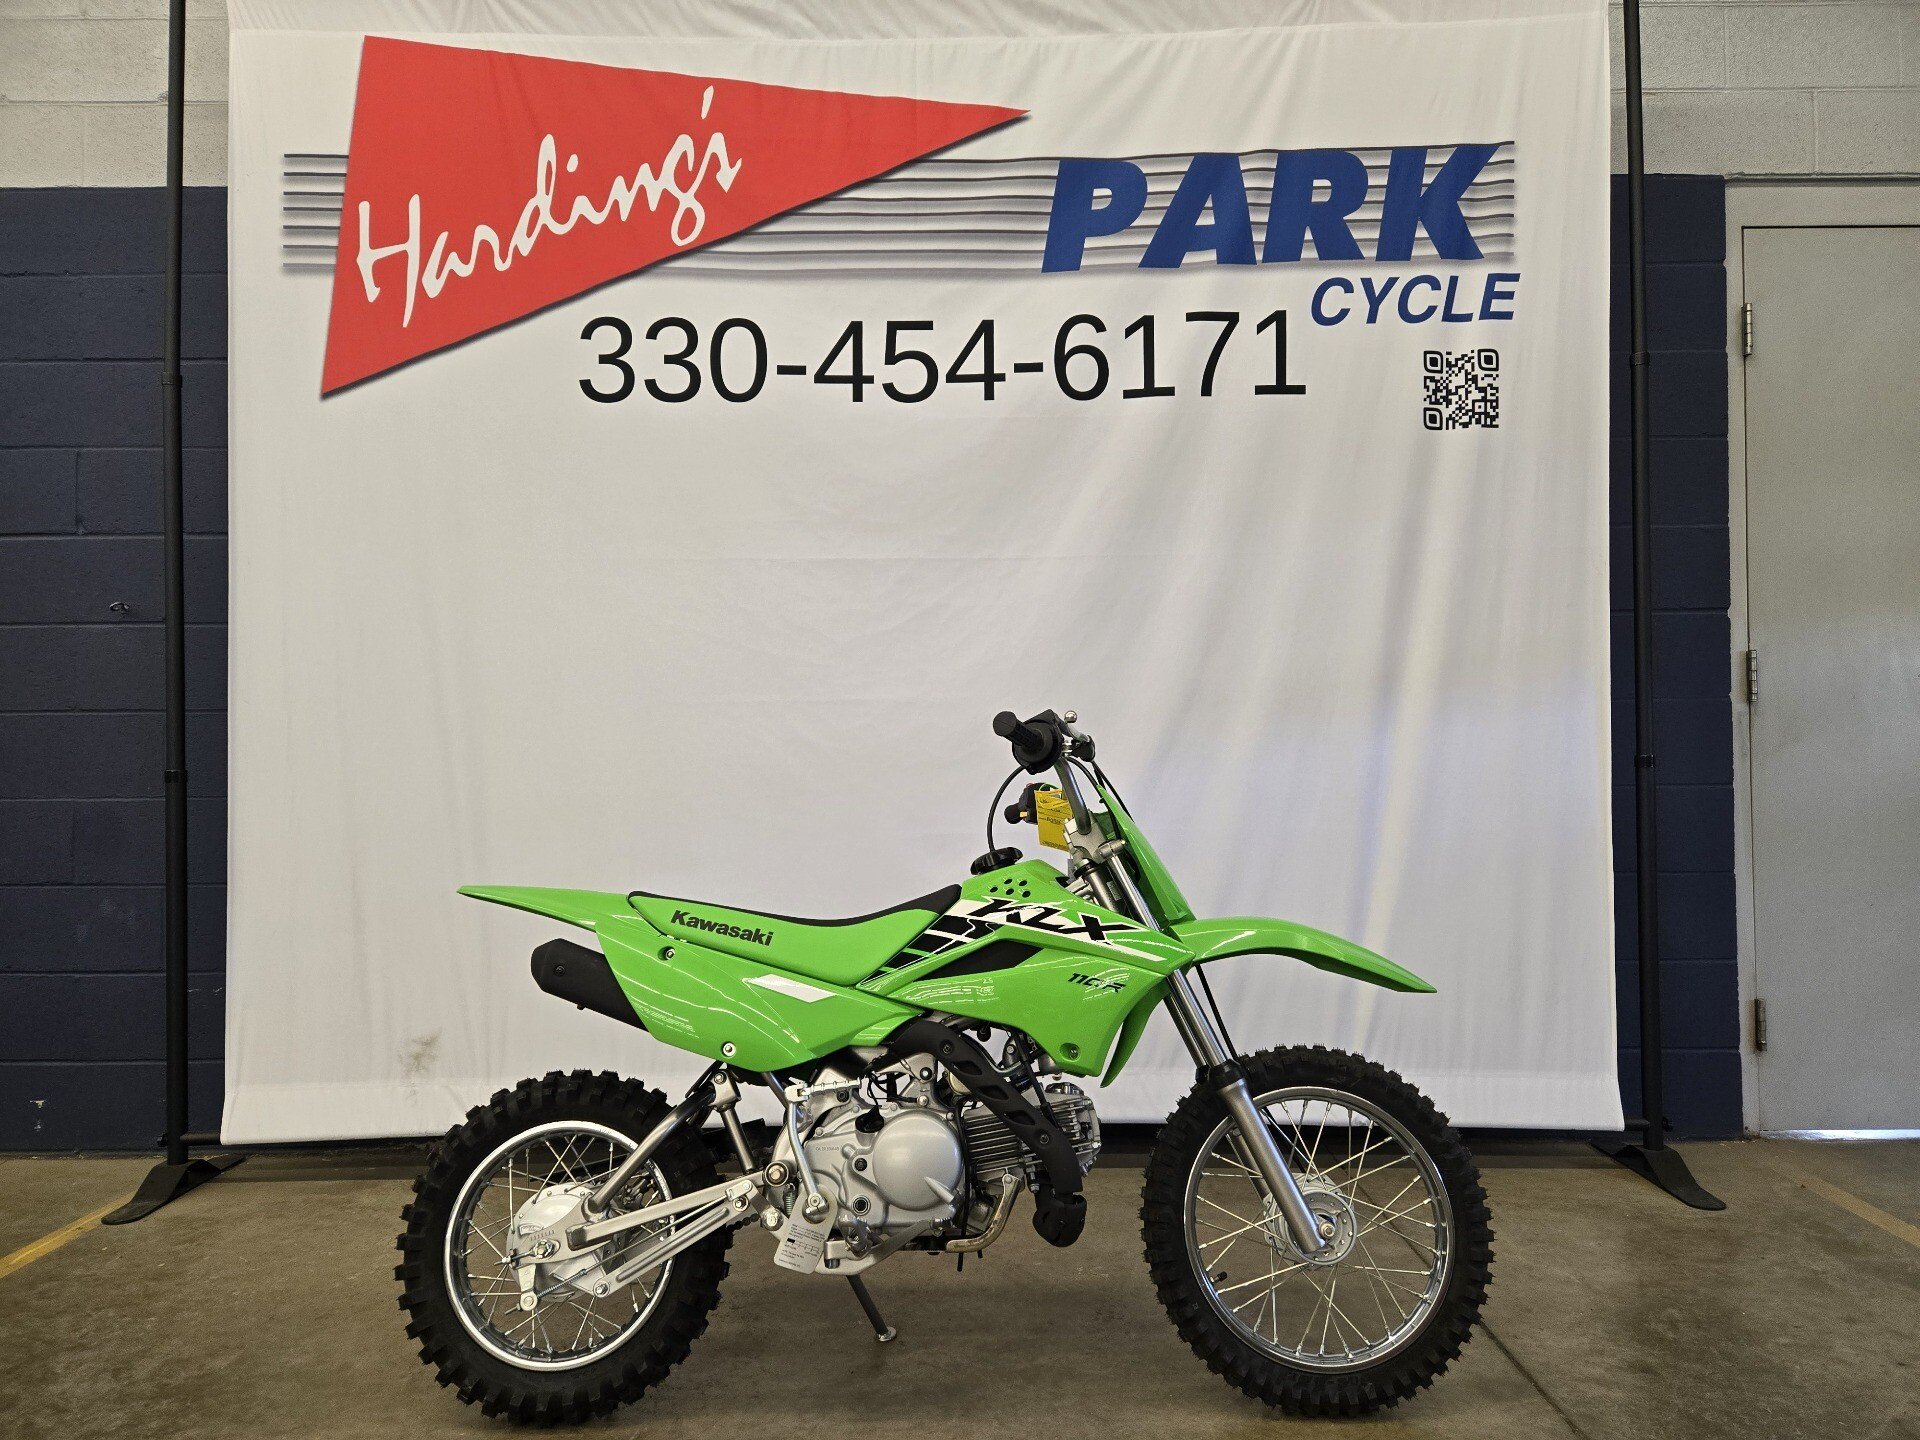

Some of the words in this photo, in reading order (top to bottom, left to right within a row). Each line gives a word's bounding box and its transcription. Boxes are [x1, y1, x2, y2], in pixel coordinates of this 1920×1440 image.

[1042, 145, 1500, 273] PARK
[1311, 272, 1521, 326] CYCLE
[578, 309, 1307, 404] 330-454-6171
[670, 909, 774, 947] Kawasaki
[966, 897, 1142, 946] KLX
